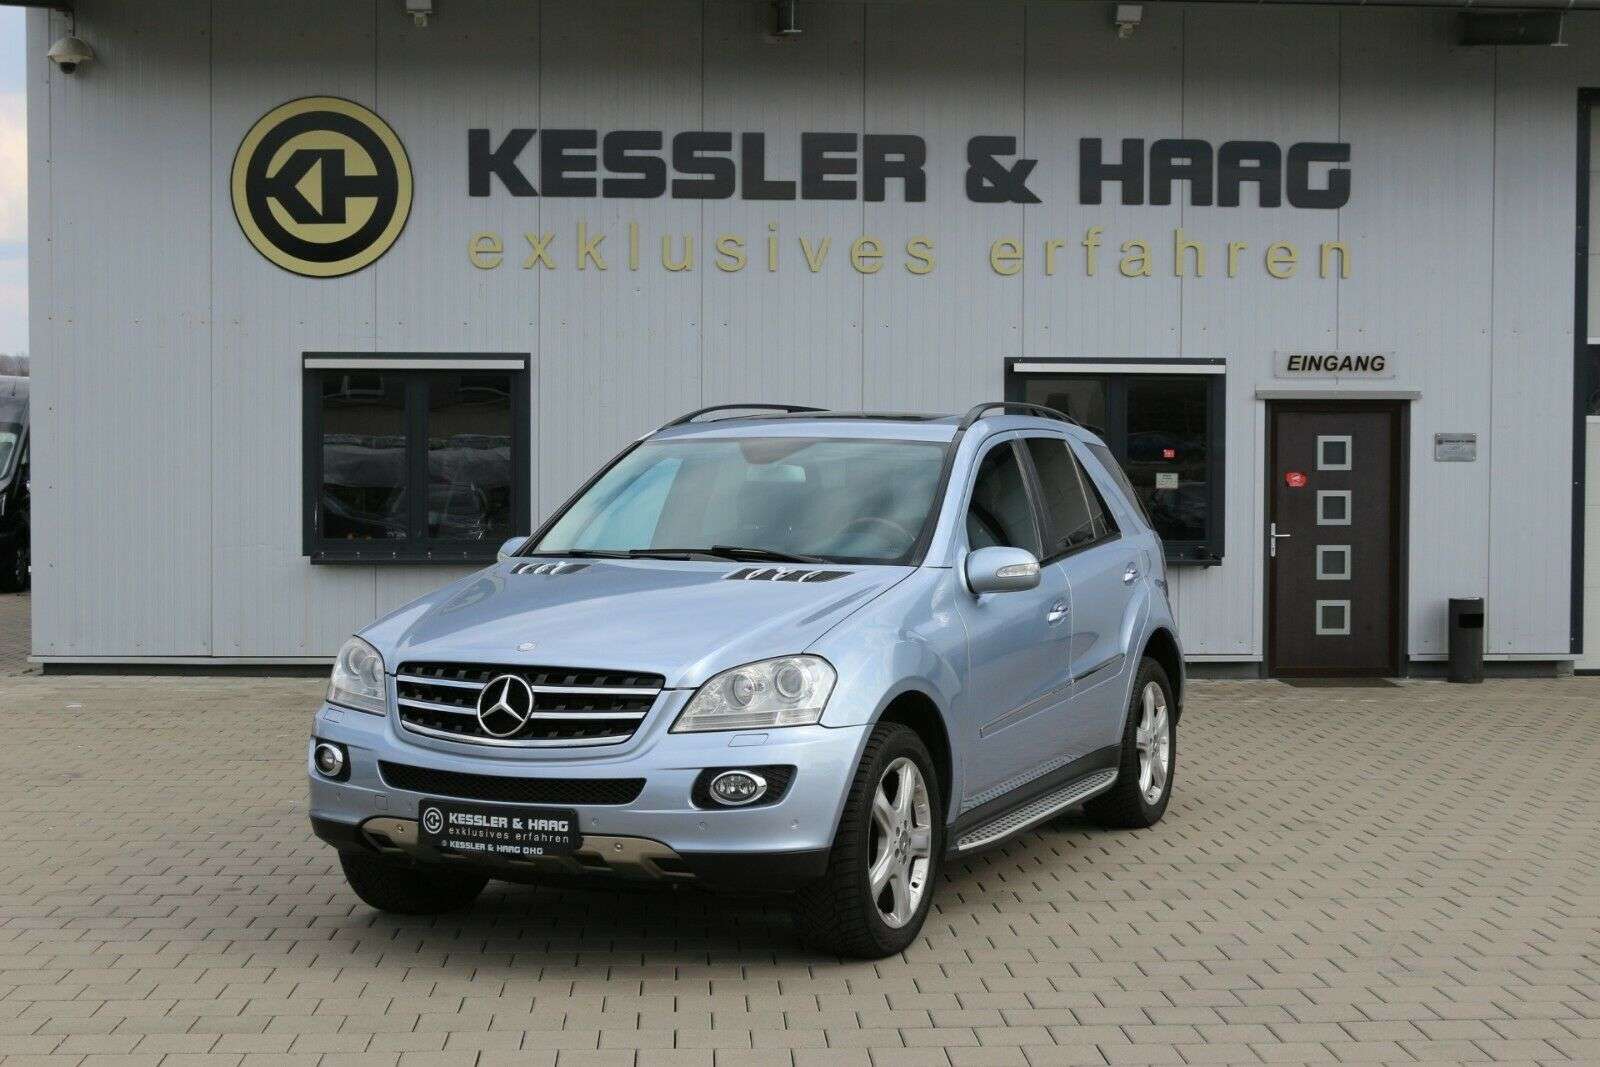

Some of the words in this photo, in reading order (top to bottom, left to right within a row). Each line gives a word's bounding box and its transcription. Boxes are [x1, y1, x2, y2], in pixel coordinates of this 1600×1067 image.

[468, 128, 927, 203] KESSLER
[966, 135, 1042, 205] &
[1079, 137, 1351, 209] HAAG
[468, 217, 936, 275] exklusives
[989, 226, 1353, 279] erfahren
[1287, 355, 1385, 372] EINGANG
[449, 812, 508, 829] KESSLER
[512, 819, 524, 830] &
[528, 818, 569, 832] HAAG
[449, 827, 509, 839] exklusives
[515, 832, 569, 844] erfahren
[449, 840, 486, 851] KESSLER
[488, 843, 495, 852] &
[497, 844, 521, 854] HAAG
